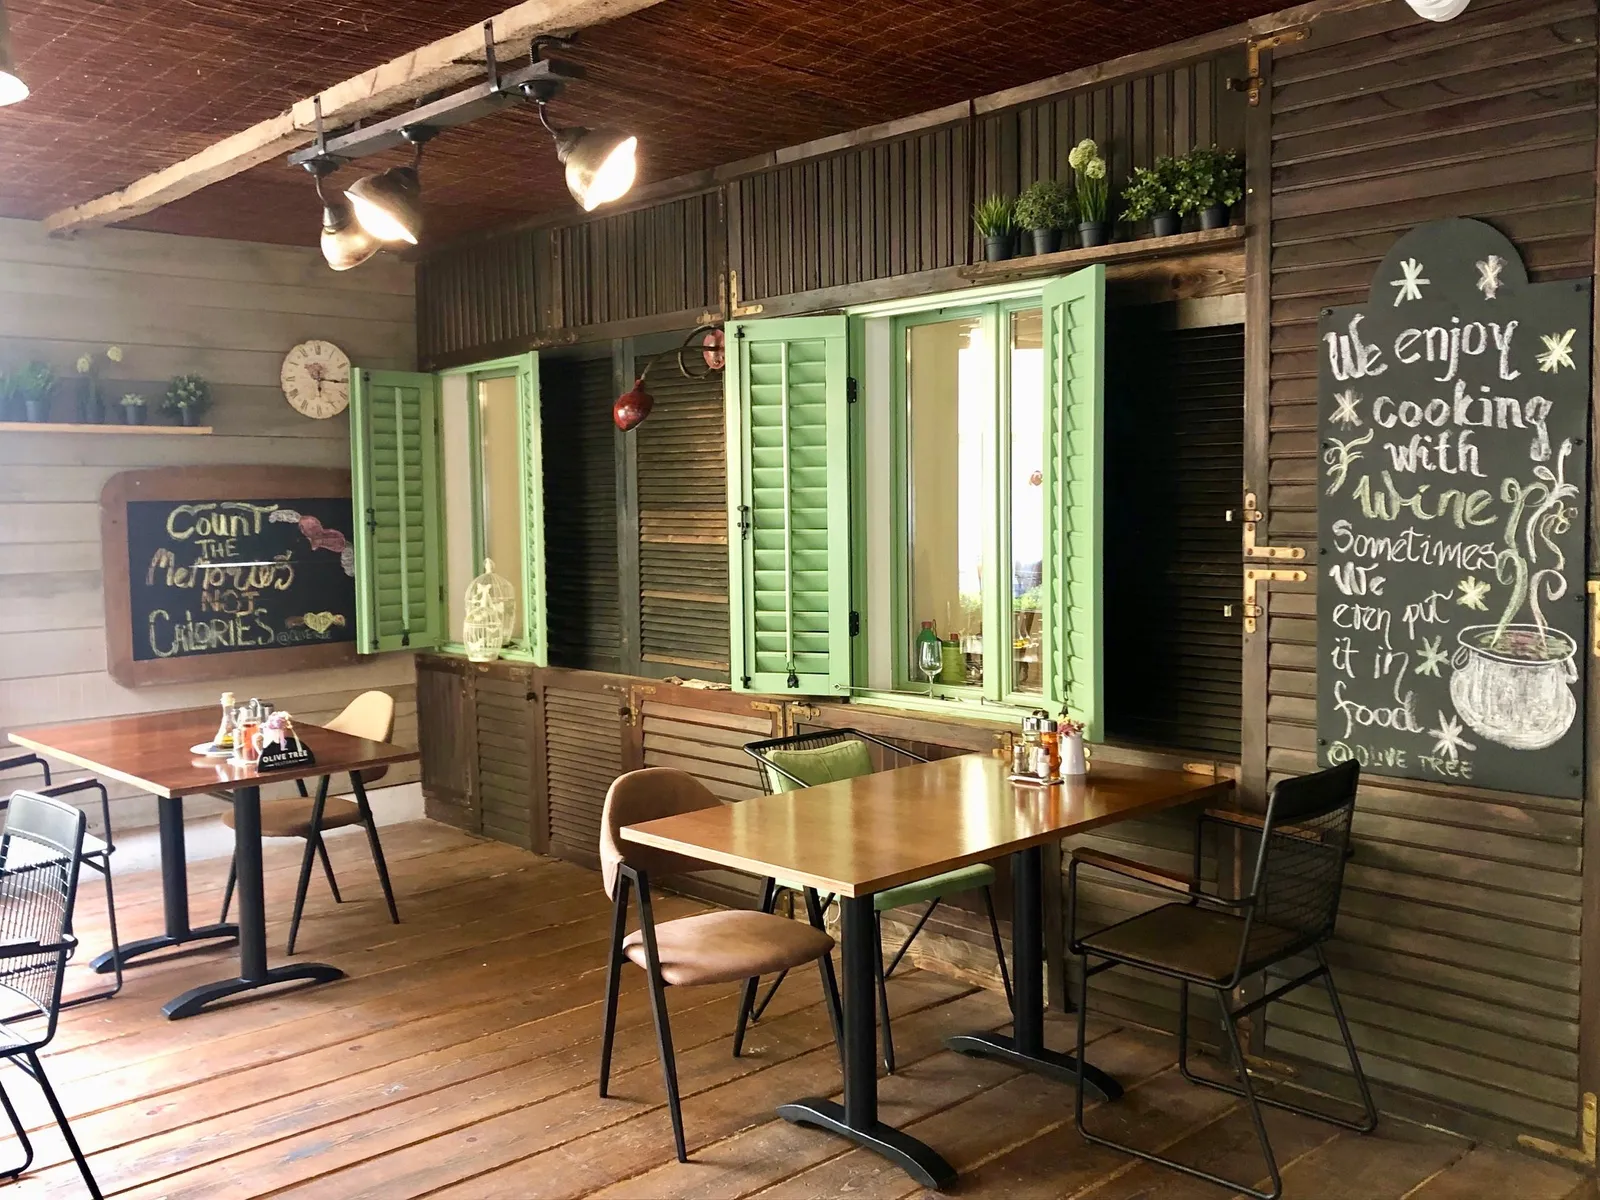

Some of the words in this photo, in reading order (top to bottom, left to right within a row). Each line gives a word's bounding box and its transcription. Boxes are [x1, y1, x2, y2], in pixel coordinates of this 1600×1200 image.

[1322, 313, 1389, 381] We
[1394, 316, 1522, 382] enjoy
[1372, 379, 1554, 462] cooking
[1383, 429, 1488, 478] with
[195, 539, 240, 559] THE
[1331, 519, 1500, 571] Sometimes
[1328, 561, 1386, 596] We
[1402, 589, 1454, 640] put
[1331, 637, 1360, 679] it
[1373, 646, 1410, 704] in
[1333, 680, 1424, 739] food
[262, 753, 287, 763] OLIVE
[287, 749, 308, 759] TREE
[1418, 755, 1475, 780] TREE
